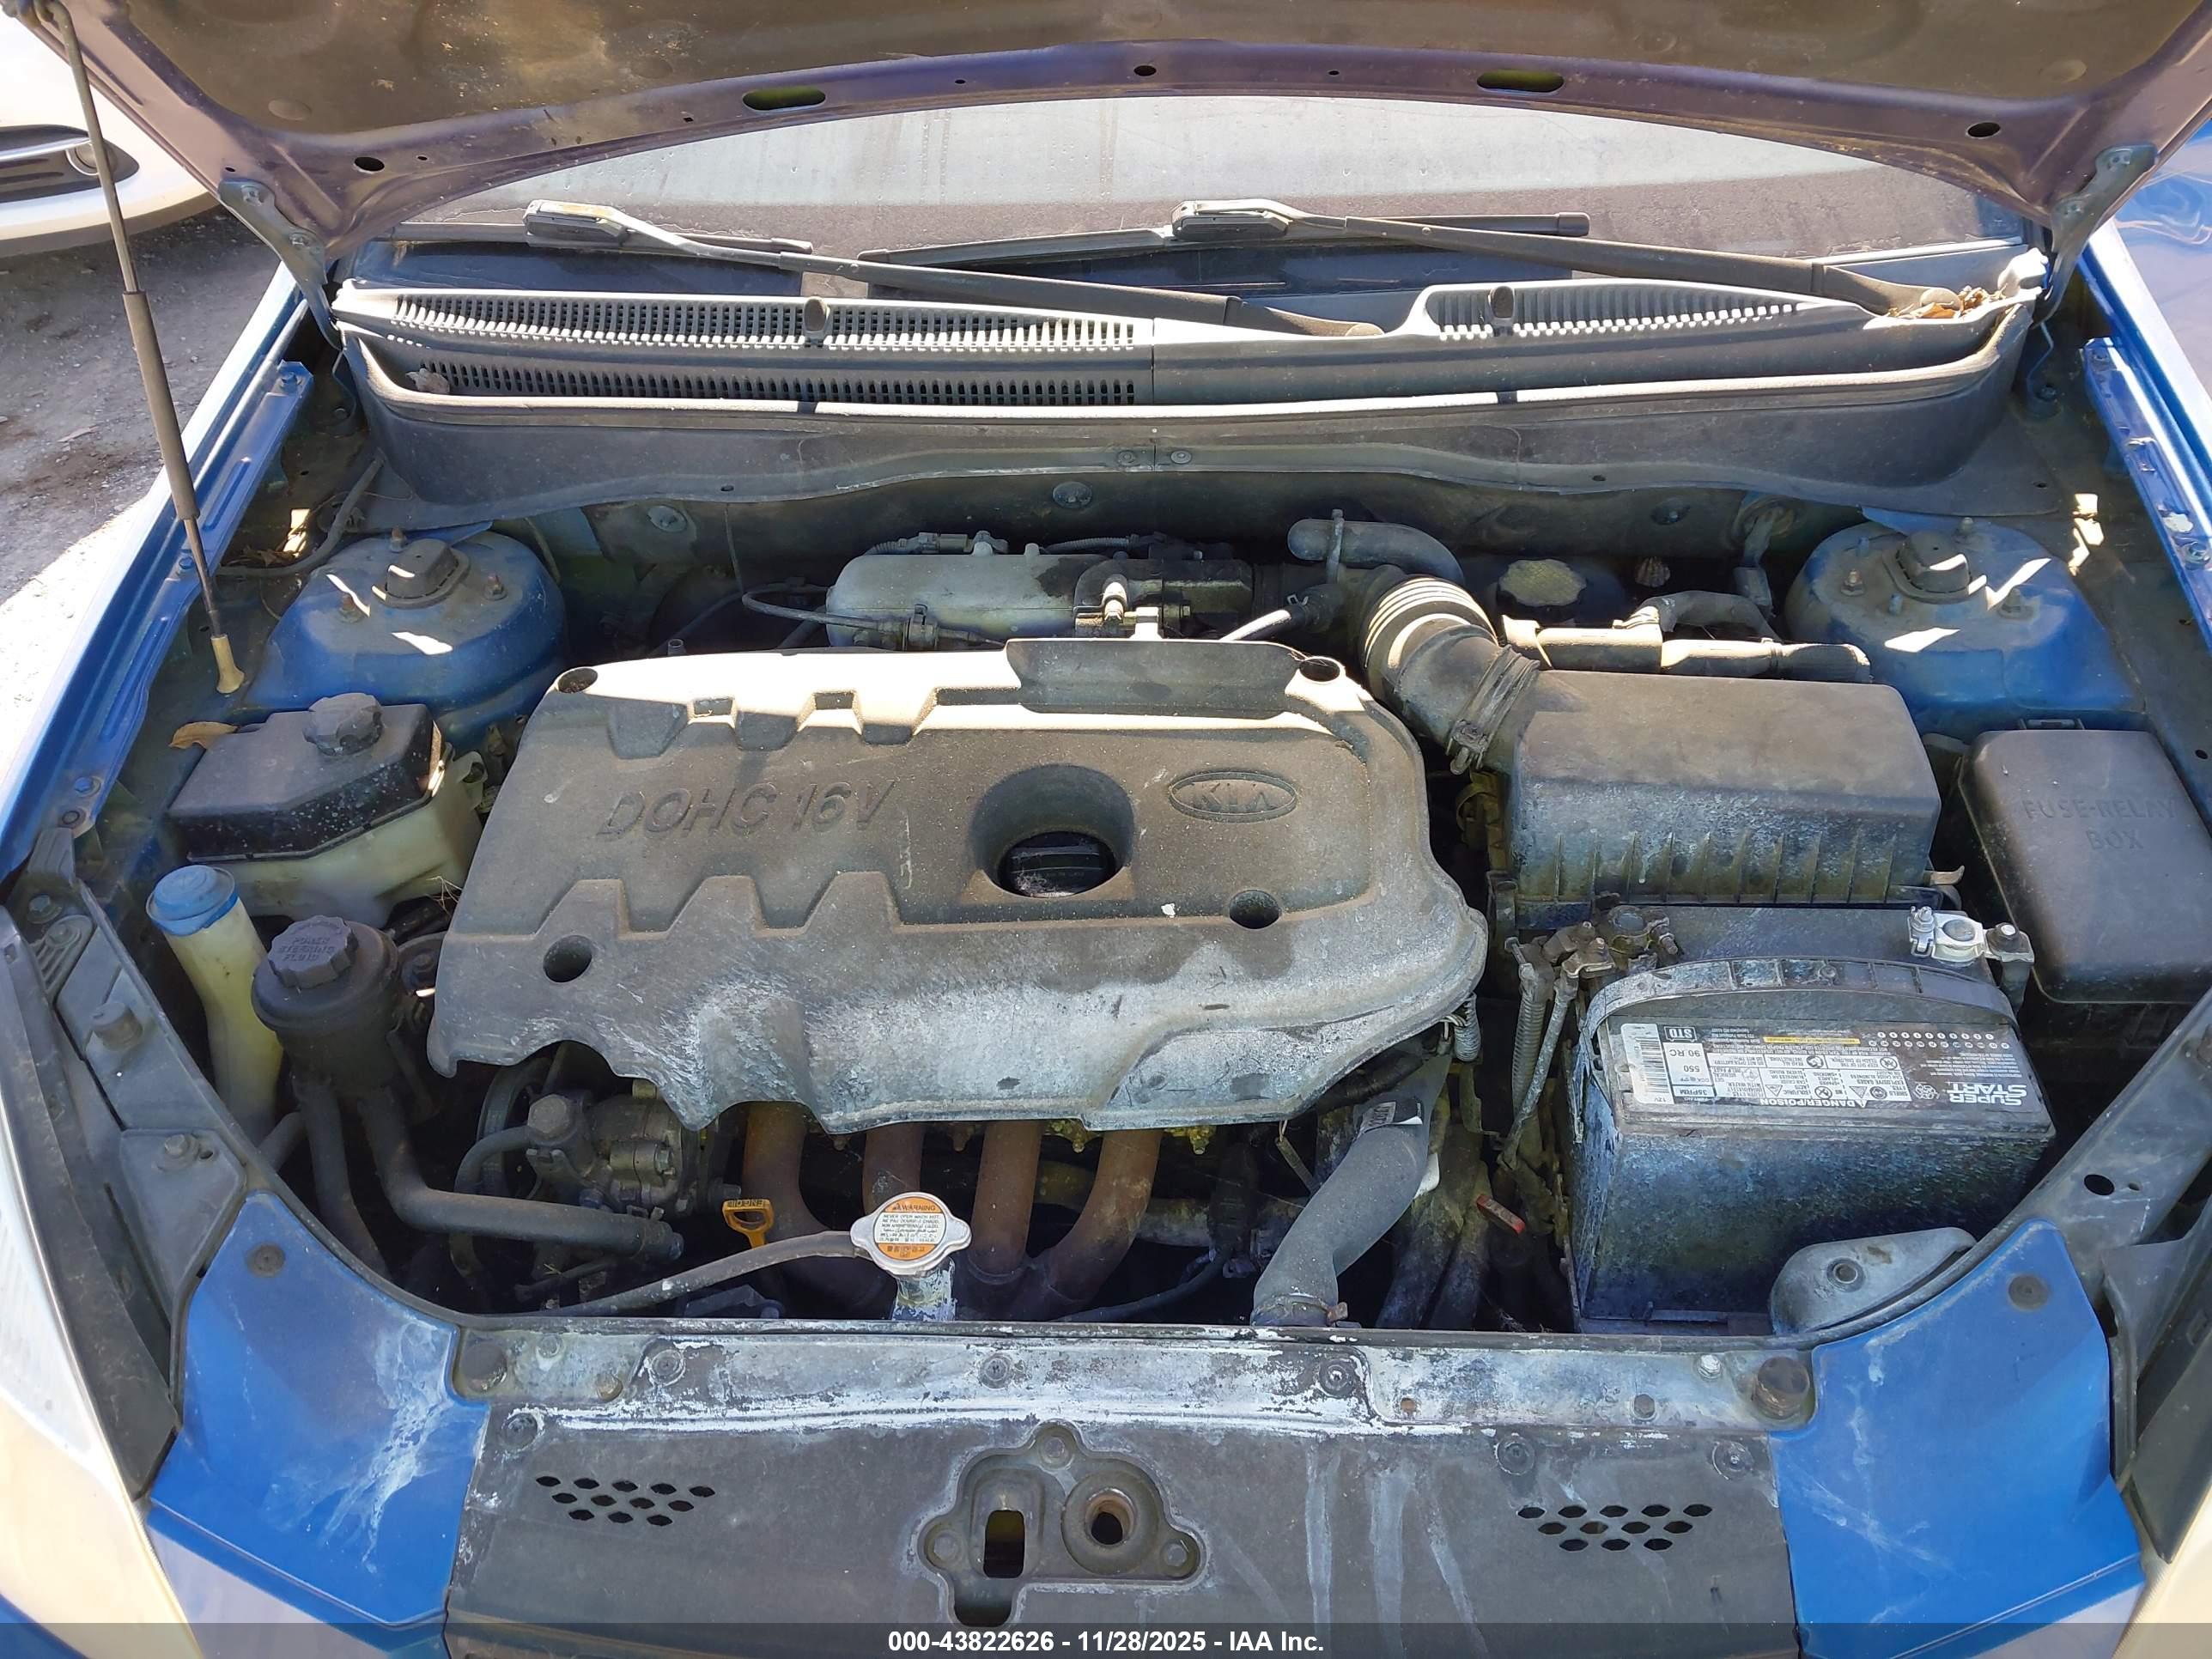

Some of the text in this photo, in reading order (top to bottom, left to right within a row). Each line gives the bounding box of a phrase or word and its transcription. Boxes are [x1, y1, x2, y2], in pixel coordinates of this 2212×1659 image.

[1190, 781, 1276, 811] KIA
[596, 779, 899, 839] DOHC 16V
[2021, 799, 2177, 818] FUSE-RELAY
[2086, 830, 2143, 849] BOX
[1668, 1028, 1692, 1038] STD
[1947, 1083, 2027, 1097] START
[1759, 1099, 1855, 1108] DANGER/POISON
[1949, 1093, 2022, 1106] SUPER
